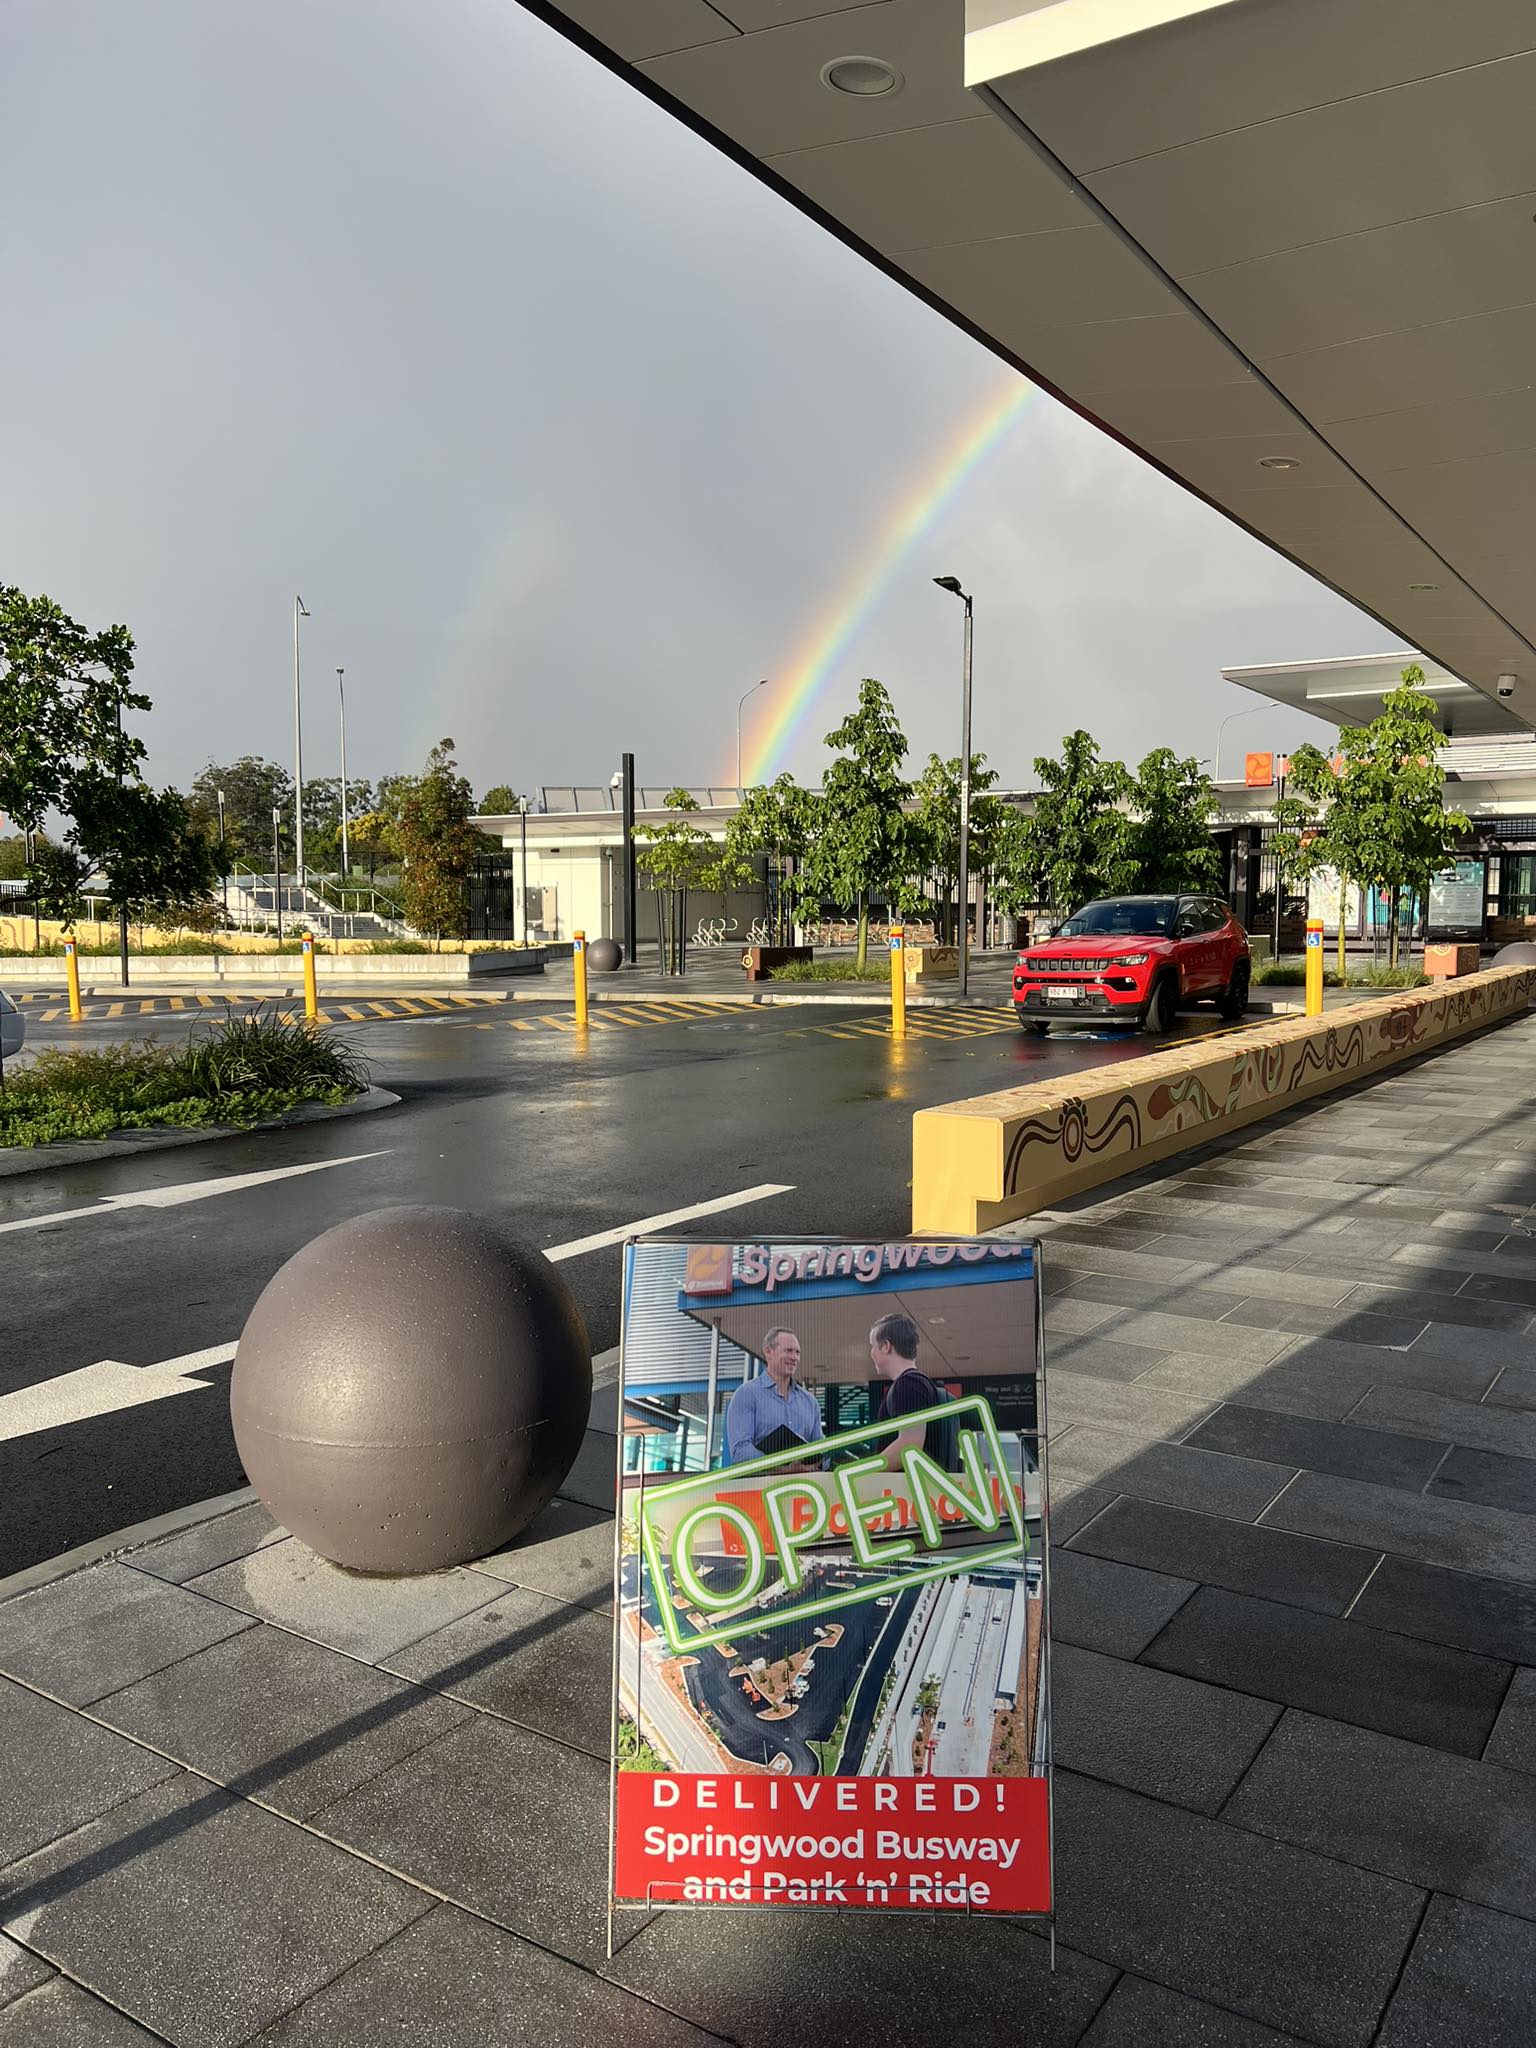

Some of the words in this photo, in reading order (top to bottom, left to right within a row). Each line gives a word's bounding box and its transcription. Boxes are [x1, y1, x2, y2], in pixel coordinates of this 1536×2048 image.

[672, 1430, 1000, 1611] OPEN
[653, 1779, 1006, 1812] DELIVERED!
[643, 1824, 864, 1864] Springwood
[876, 1830, 1020, 1868] Busway
[683, 1870, 750, 1900] and
[763, 1870, 847, 1902] Park
[909, 1873, 990, 1904] Ride
